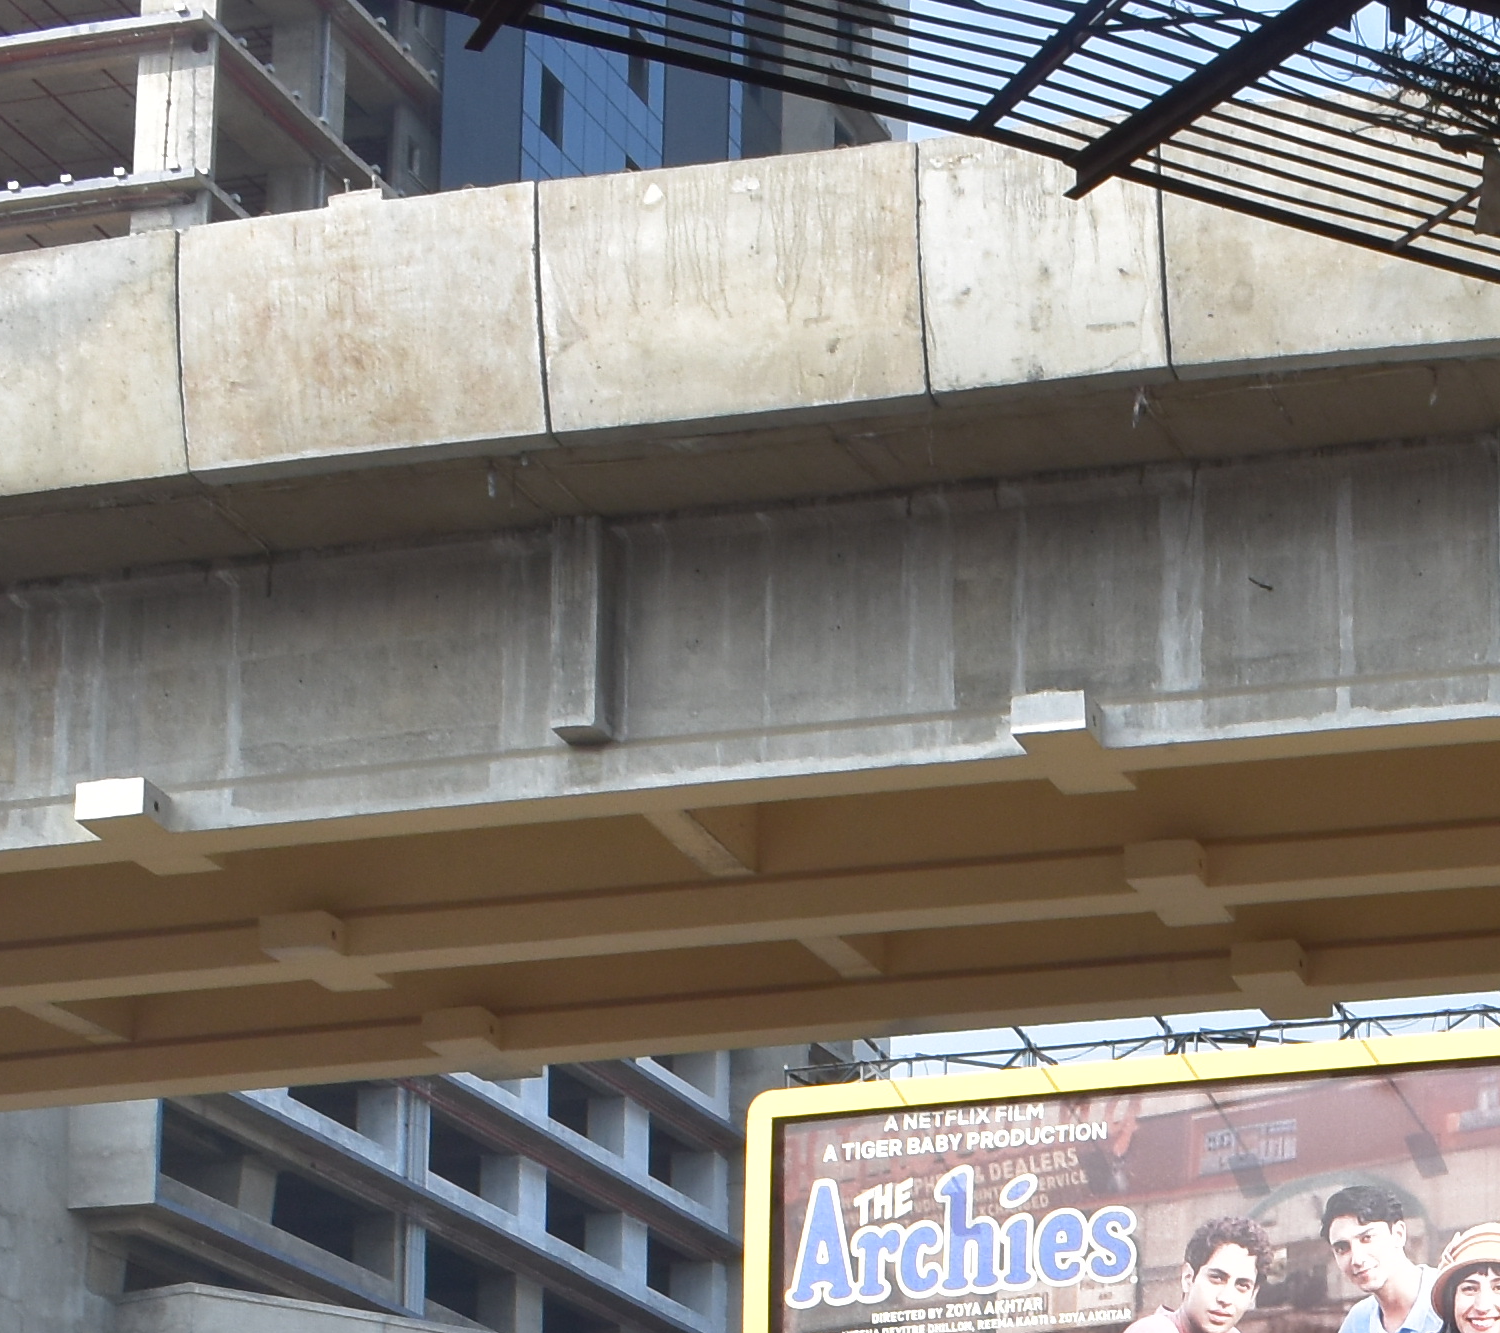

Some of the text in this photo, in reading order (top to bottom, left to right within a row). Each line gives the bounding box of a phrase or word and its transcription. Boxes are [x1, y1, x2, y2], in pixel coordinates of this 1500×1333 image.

[884, 1103, 1044, 1132] A NETFLIX FILM
[823, 1121, 1107, 1163] A TIGER BABY PRODUCTION
[854, 1178, 913, 1226] THE
[785, 1164, 1138, 1309] Archies
[871, 1297, 1044, 1325] DIRECTED BY ZOYA AKHTAR
[977, 1317, 1014, 1330] REEMA
[1058, 1311, 1086, 1324] ZOYA
[1087, 1308, 1132, 1323] AKHTAR
